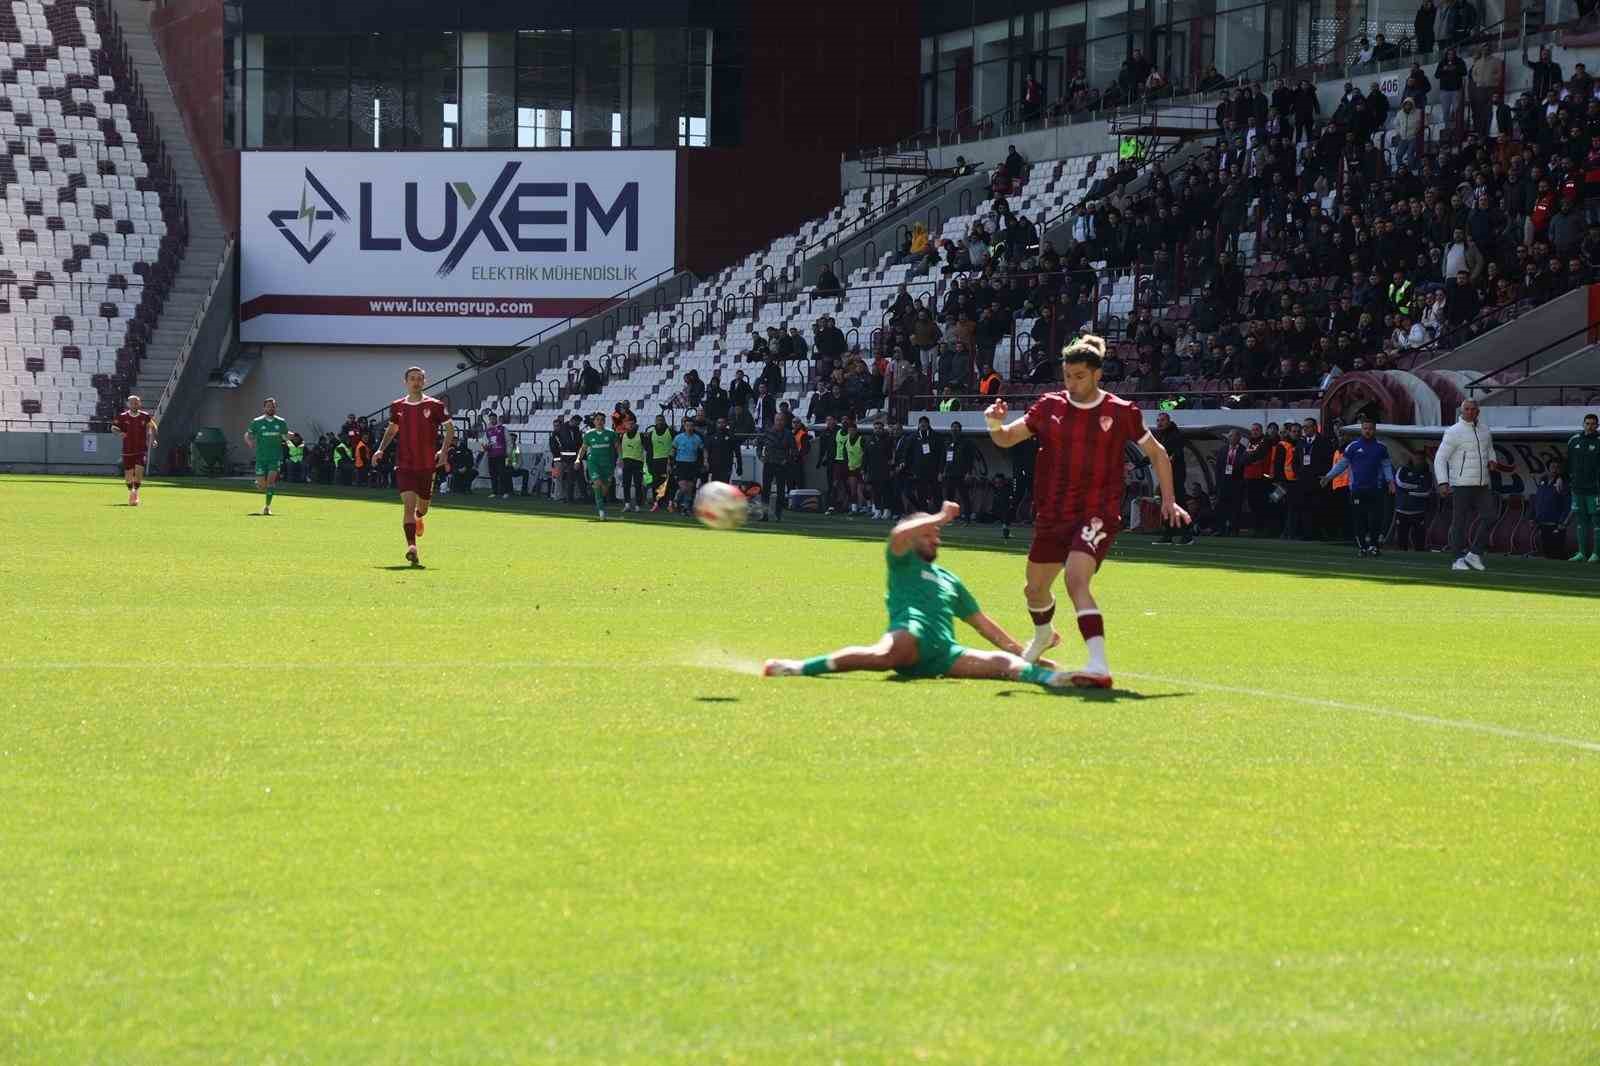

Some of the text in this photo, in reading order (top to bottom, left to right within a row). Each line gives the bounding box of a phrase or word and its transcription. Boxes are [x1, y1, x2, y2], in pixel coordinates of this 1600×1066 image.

[360, 161, 639, 279] LUXEM
[471, 265, 638, 281] ELEKTRİK MÜHENDİSLİK
[369, 299, 534, 316] www.luxemgrup.com
